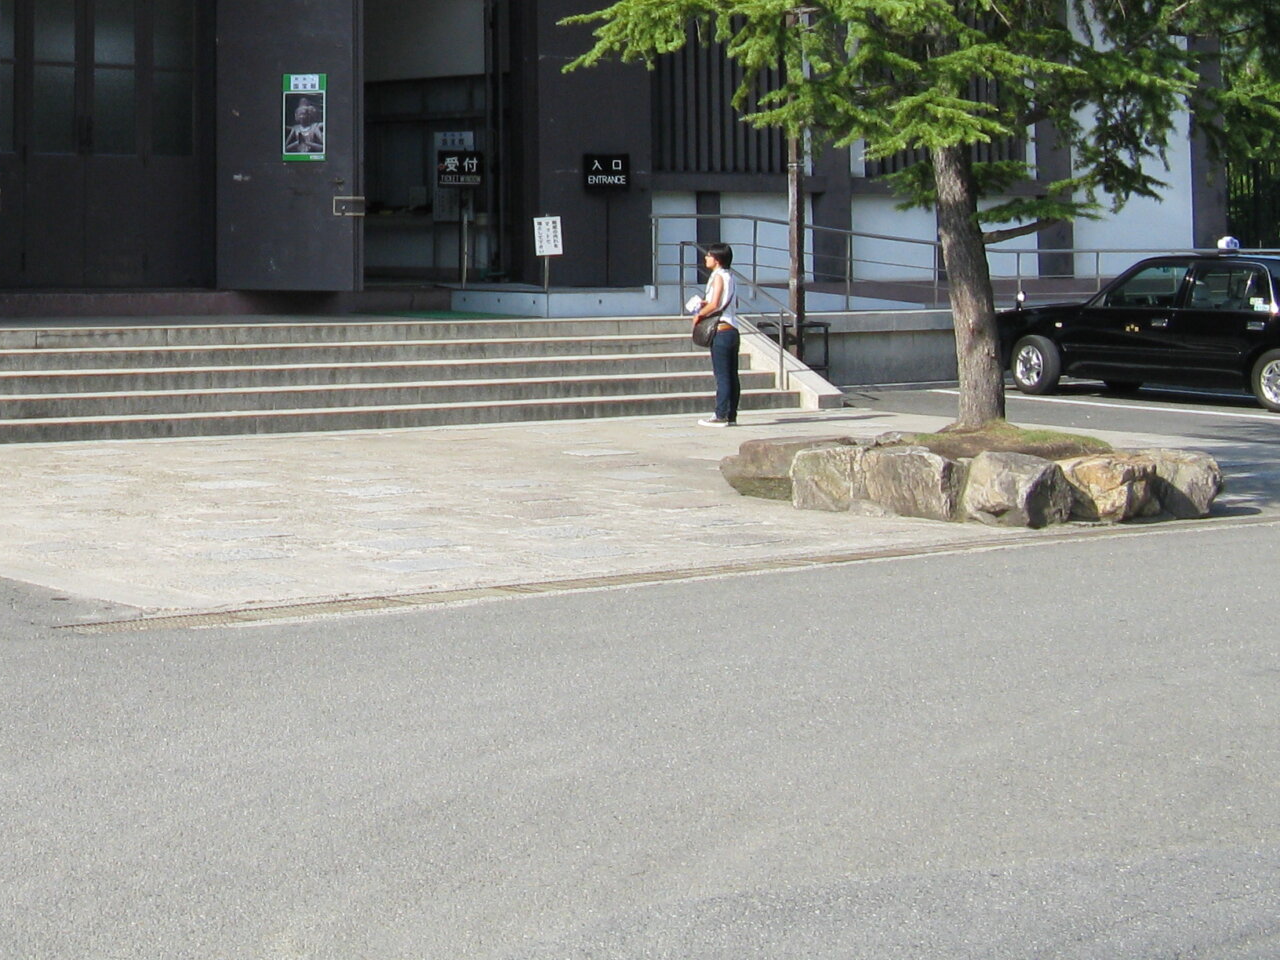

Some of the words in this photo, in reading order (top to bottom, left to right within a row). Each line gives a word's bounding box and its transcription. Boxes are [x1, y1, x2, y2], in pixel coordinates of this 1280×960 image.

[444, 156, 478, 172] 受付
[592, 160, 622, 170] 入口
[588, 175, 626, 185] ENTRANCE
